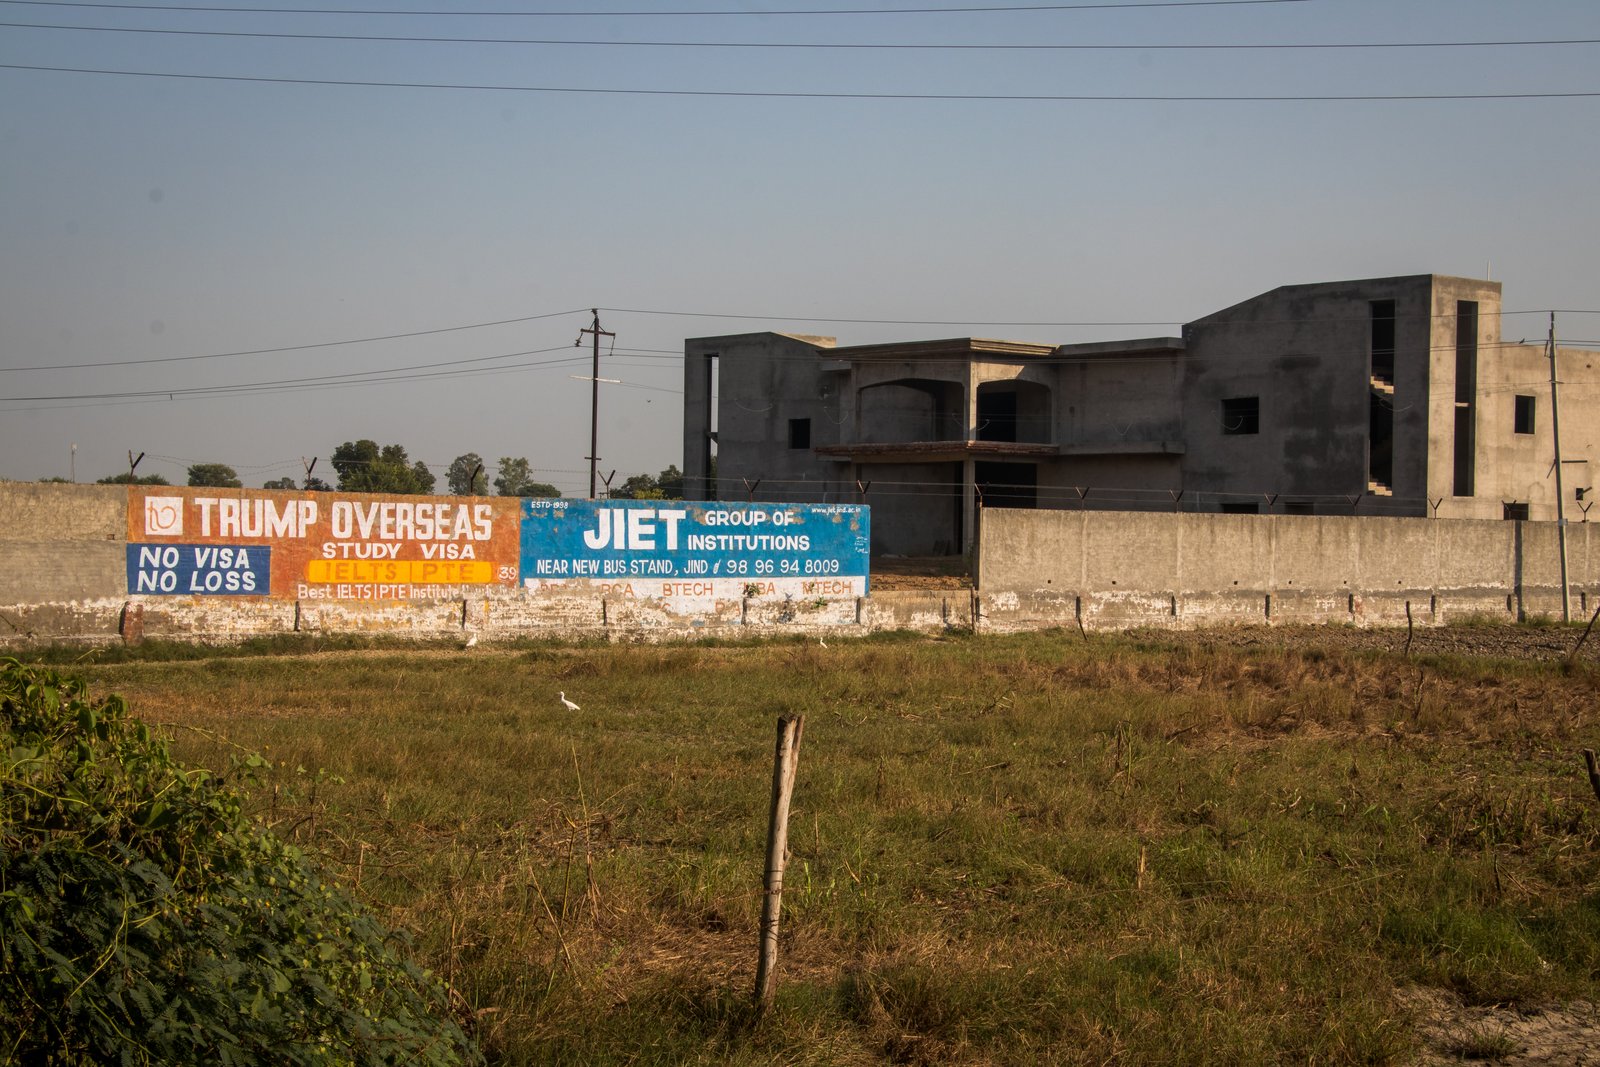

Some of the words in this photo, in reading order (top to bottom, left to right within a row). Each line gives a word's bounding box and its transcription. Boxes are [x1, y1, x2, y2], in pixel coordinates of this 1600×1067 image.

[195, 498, 318, 538] TRUMP
[331, 501, 492, 541] OVERSEAS
[705, 510, 766, 527] GROUP
[773, 511, 795, 526] OF
[583, 508, 687, 550] JIET
[322, 542, 402, 559] STUDY
[420, 543, 476, 560] VISA
[688, 535, 810, 551] INSTITUTIONS
[139, 547, 180, 569] NO
[194, 547, 250, 569] VISA
[325, 562, 398, 581] IELTS
[422, 562, 474, 581] PTE
[498, 566, 518, 580] 39
[537, 559, 569, 574] NEAR
[572, 559, 600, 574] NEW
[603, 560, 627, 574] BUS
[630, 560, 679, 576] STAND,
[683, 560, 709, 574] JIND
[726, 559, 748, 574] 98
[755, 559, 774, 574] 96
[780, 559, 800, 574] 94
[805, 559, 839, 574] 8009
[137, 570, 177, 592] NO
[189, 570, 256, 592] LOSS
[662, 582, 714, 597] BTECH
[297, 584, 332, 599] Best
